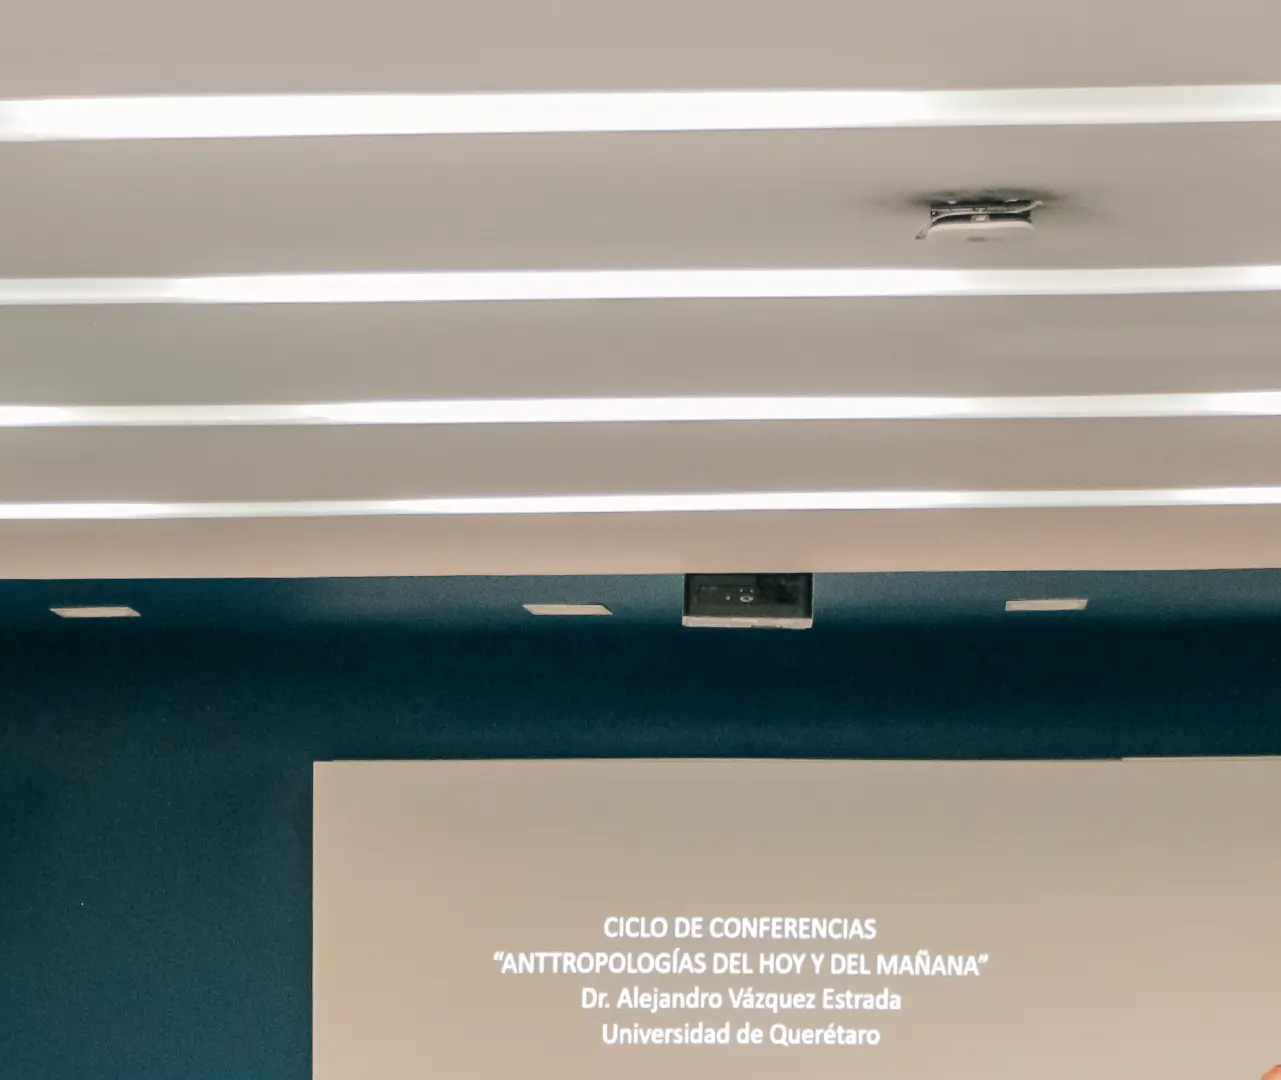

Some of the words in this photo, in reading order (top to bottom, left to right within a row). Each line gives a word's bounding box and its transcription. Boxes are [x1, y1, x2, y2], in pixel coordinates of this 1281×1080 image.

[604, 917, 668, 938] CICLO
[675, 917, 703, 938] DE
[710, 917, 877, 939] CONFERENCIAS
[713, 953, 753, 973] DEL
[760, 953, 805, 974] HOY
[811, 954, 824, 974] Y
[831, 954, 871, 974] DEL
[582, 988, 610, 1008] Dr.
[617, 986, 722, 1013] Alejandro
[729, 987, 815, 1013] Vázquez
[823, 988, 901, 1009] Estrada
[603, 1022, 729, 1044] Universidad
[737, 1022, 763, 1044] de
[770, 1023, 880, 1046] Querétaro
